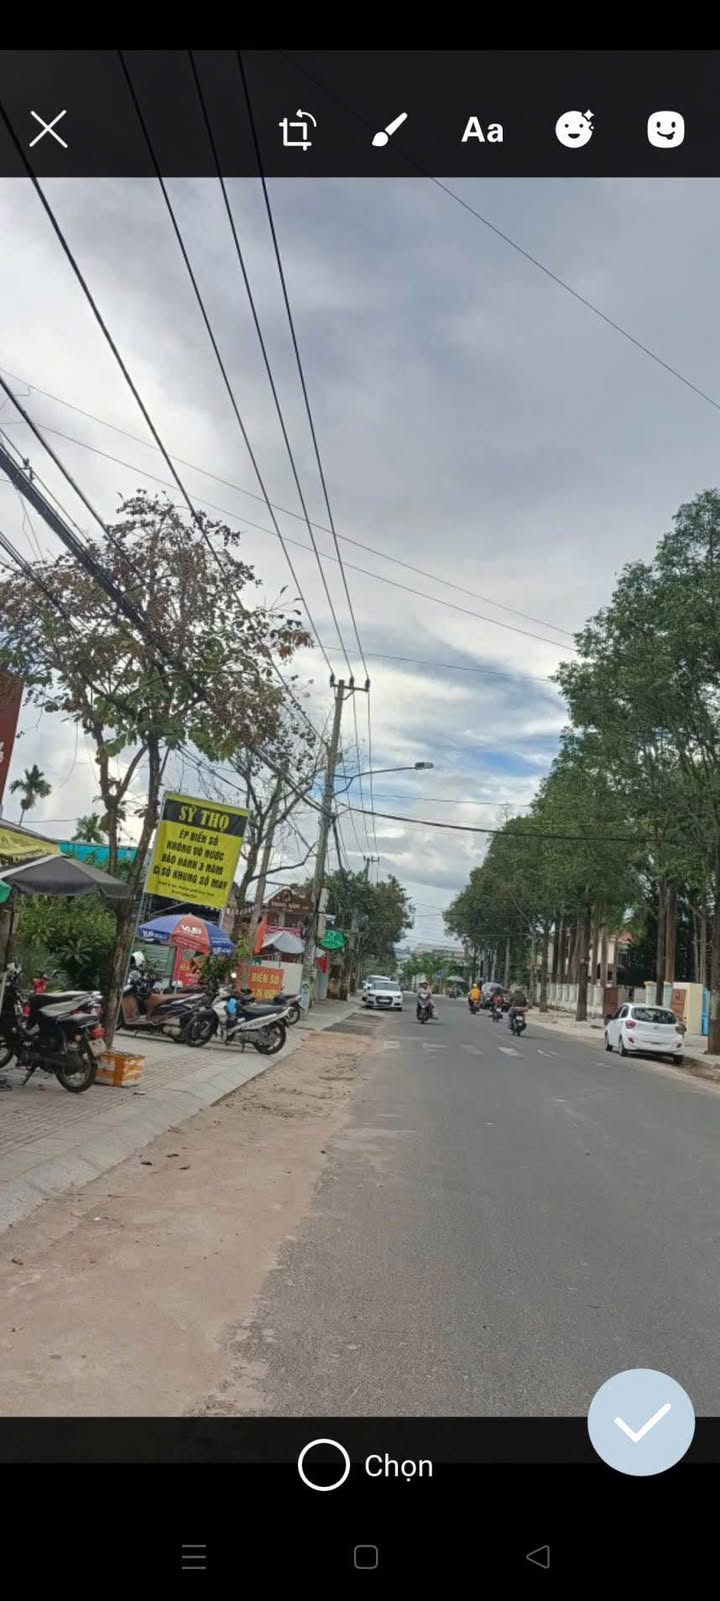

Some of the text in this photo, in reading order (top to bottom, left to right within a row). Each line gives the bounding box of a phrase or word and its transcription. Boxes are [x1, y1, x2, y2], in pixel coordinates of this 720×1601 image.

[201, 810, 230, 832] THỌ
[167, 841, 192, 854] KHÔNG
[173, 871, 198, 884] KHUNG
